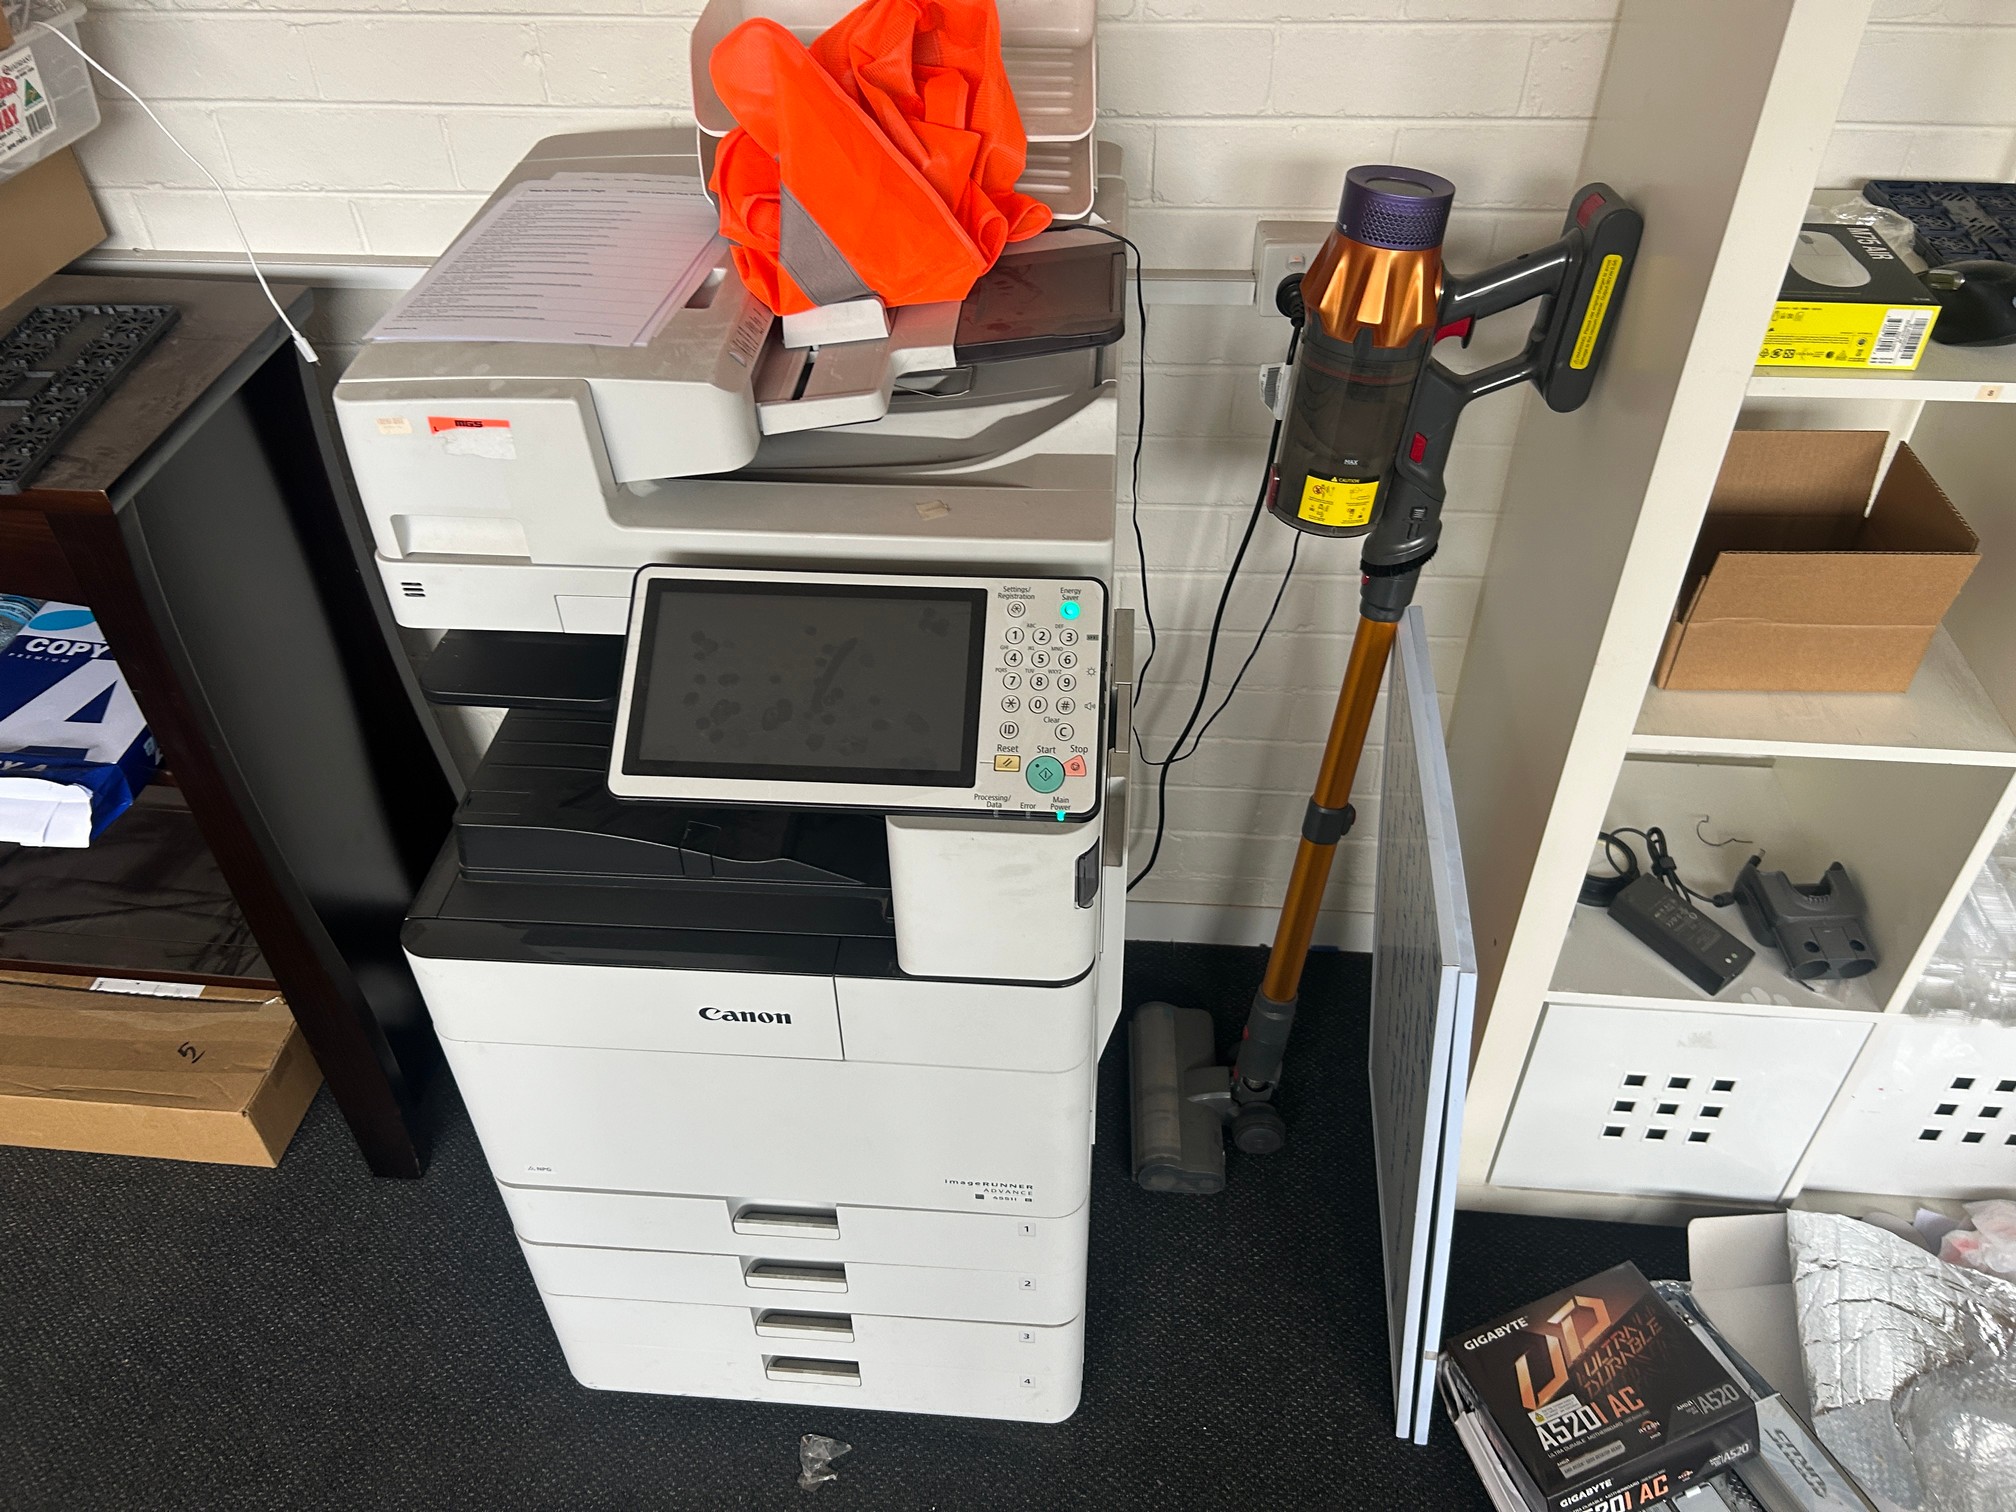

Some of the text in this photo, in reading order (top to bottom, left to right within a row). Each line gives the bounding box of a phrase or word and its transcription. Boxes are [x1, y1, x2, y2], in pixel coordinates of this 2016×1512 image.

[1862, 246, 1894, 259] AIR
[1003, 586, 1031, 594] Settings/
[25, 638, 110, 658] COPY
[8, 653, 70, 663] PREMIUM
[997, 744, 1018, 752] Reset
[1036, 746, 1056, 754] Start
[1070, 745, 1088, 754] Stop
[974, 794, 1011, 802] Processing/
[698, 1007, 792, 1024] Canon
[944, 1179, 1033, 1190] imageRUNNER
[983, 1188, 1032, 1196] ADVANCE
[1464, 1316, 1529, 1350] GIGABYTE
[1607, 1386, 1645, 1418] AC
[1697, 1384, 1740, 1415] A520
[1638, 1421, 1660, 1434] RYZEN
[1548, 1449, 1564, 1458] ULTRA
[1564, 1439, 1586, 1452] DURABLE
[1724, 1443, 1749, 1463] A520
[1560, 1478, 1612, 1508] GIGABYTE
[1640, 1474, 1669, 1504] AC
